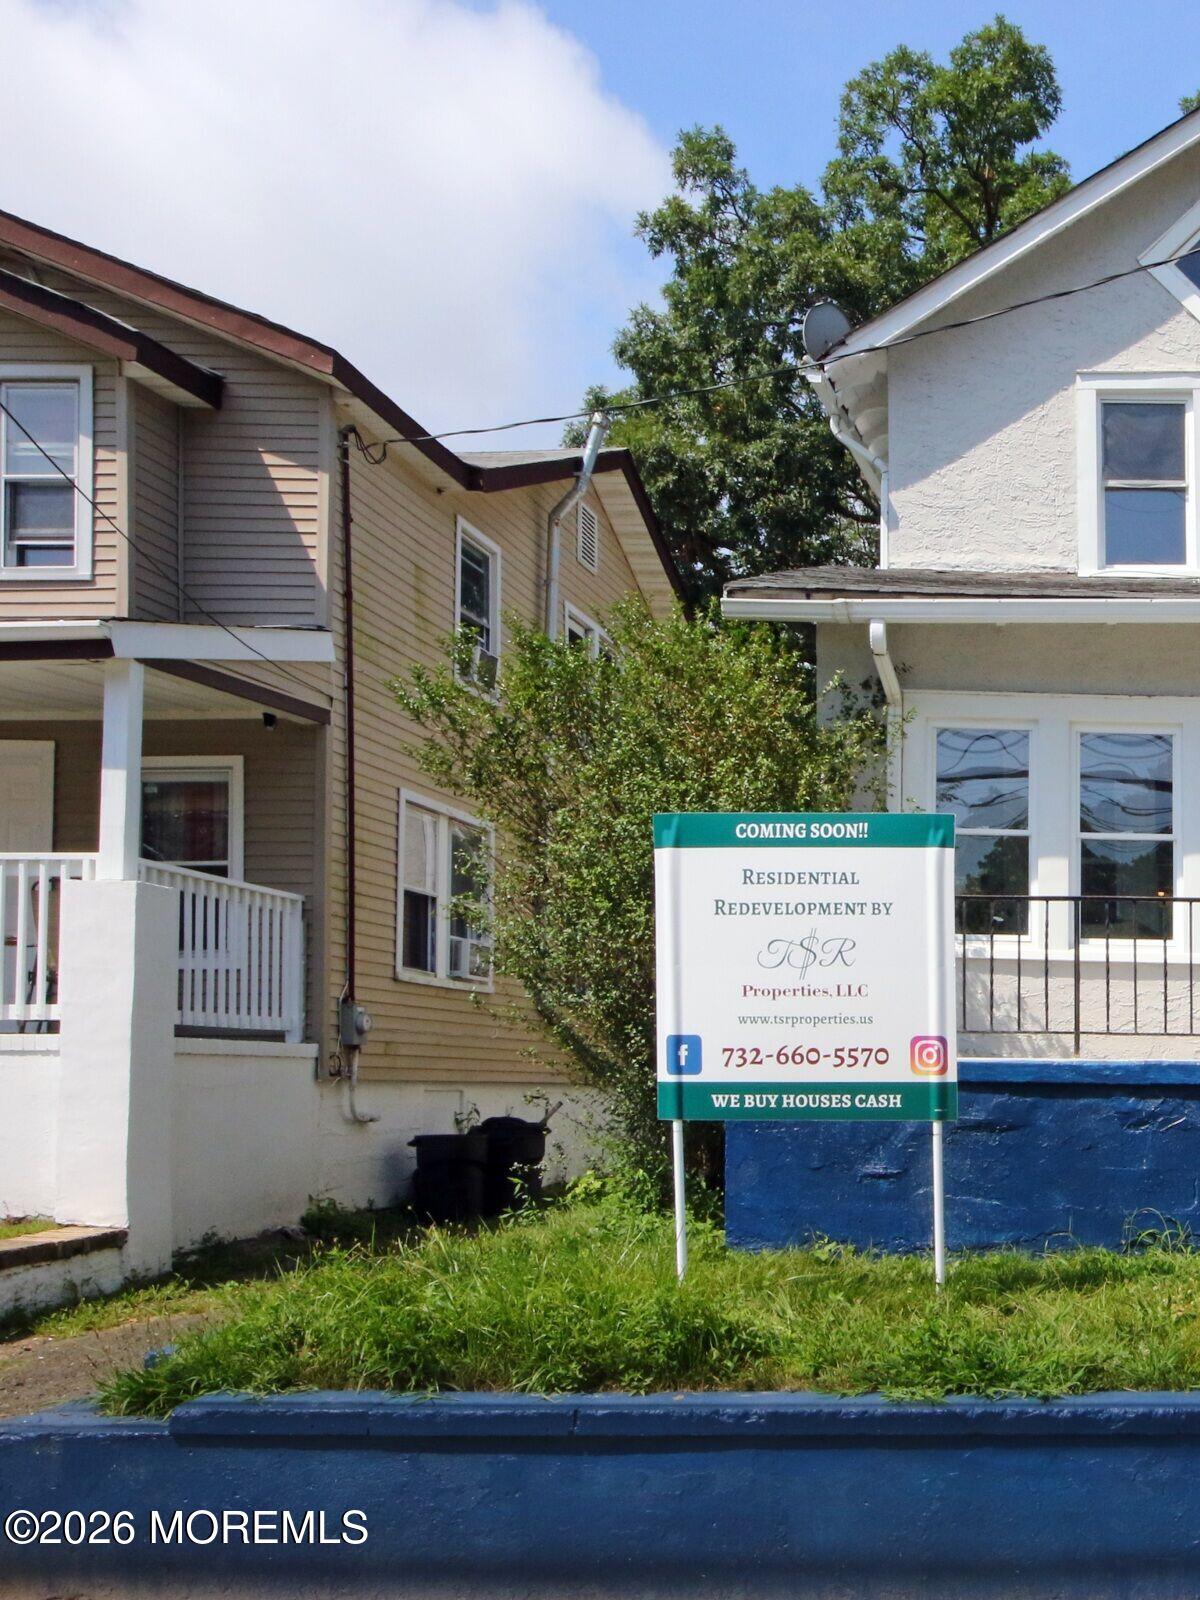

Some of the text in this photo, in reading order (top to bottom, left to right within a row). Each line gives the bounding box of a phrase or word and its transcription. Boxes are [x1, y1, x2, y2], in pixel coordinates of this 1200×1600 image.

[735, 822, 869, 838] COMING SOON!!
[742, 868, 860, 885] RESIDENTIAL
[714, 899, 893, 916] REDEVELOPMENT BY
[742, 983, 869, 1001] Properties, LLC
[738, 1012, 874, 1028] www.tsrproperties.us
[721, 1044, 889, 1069] 732-660-5570
[711, 1094, 902, 1109] WE BUY HOUSES CASH
